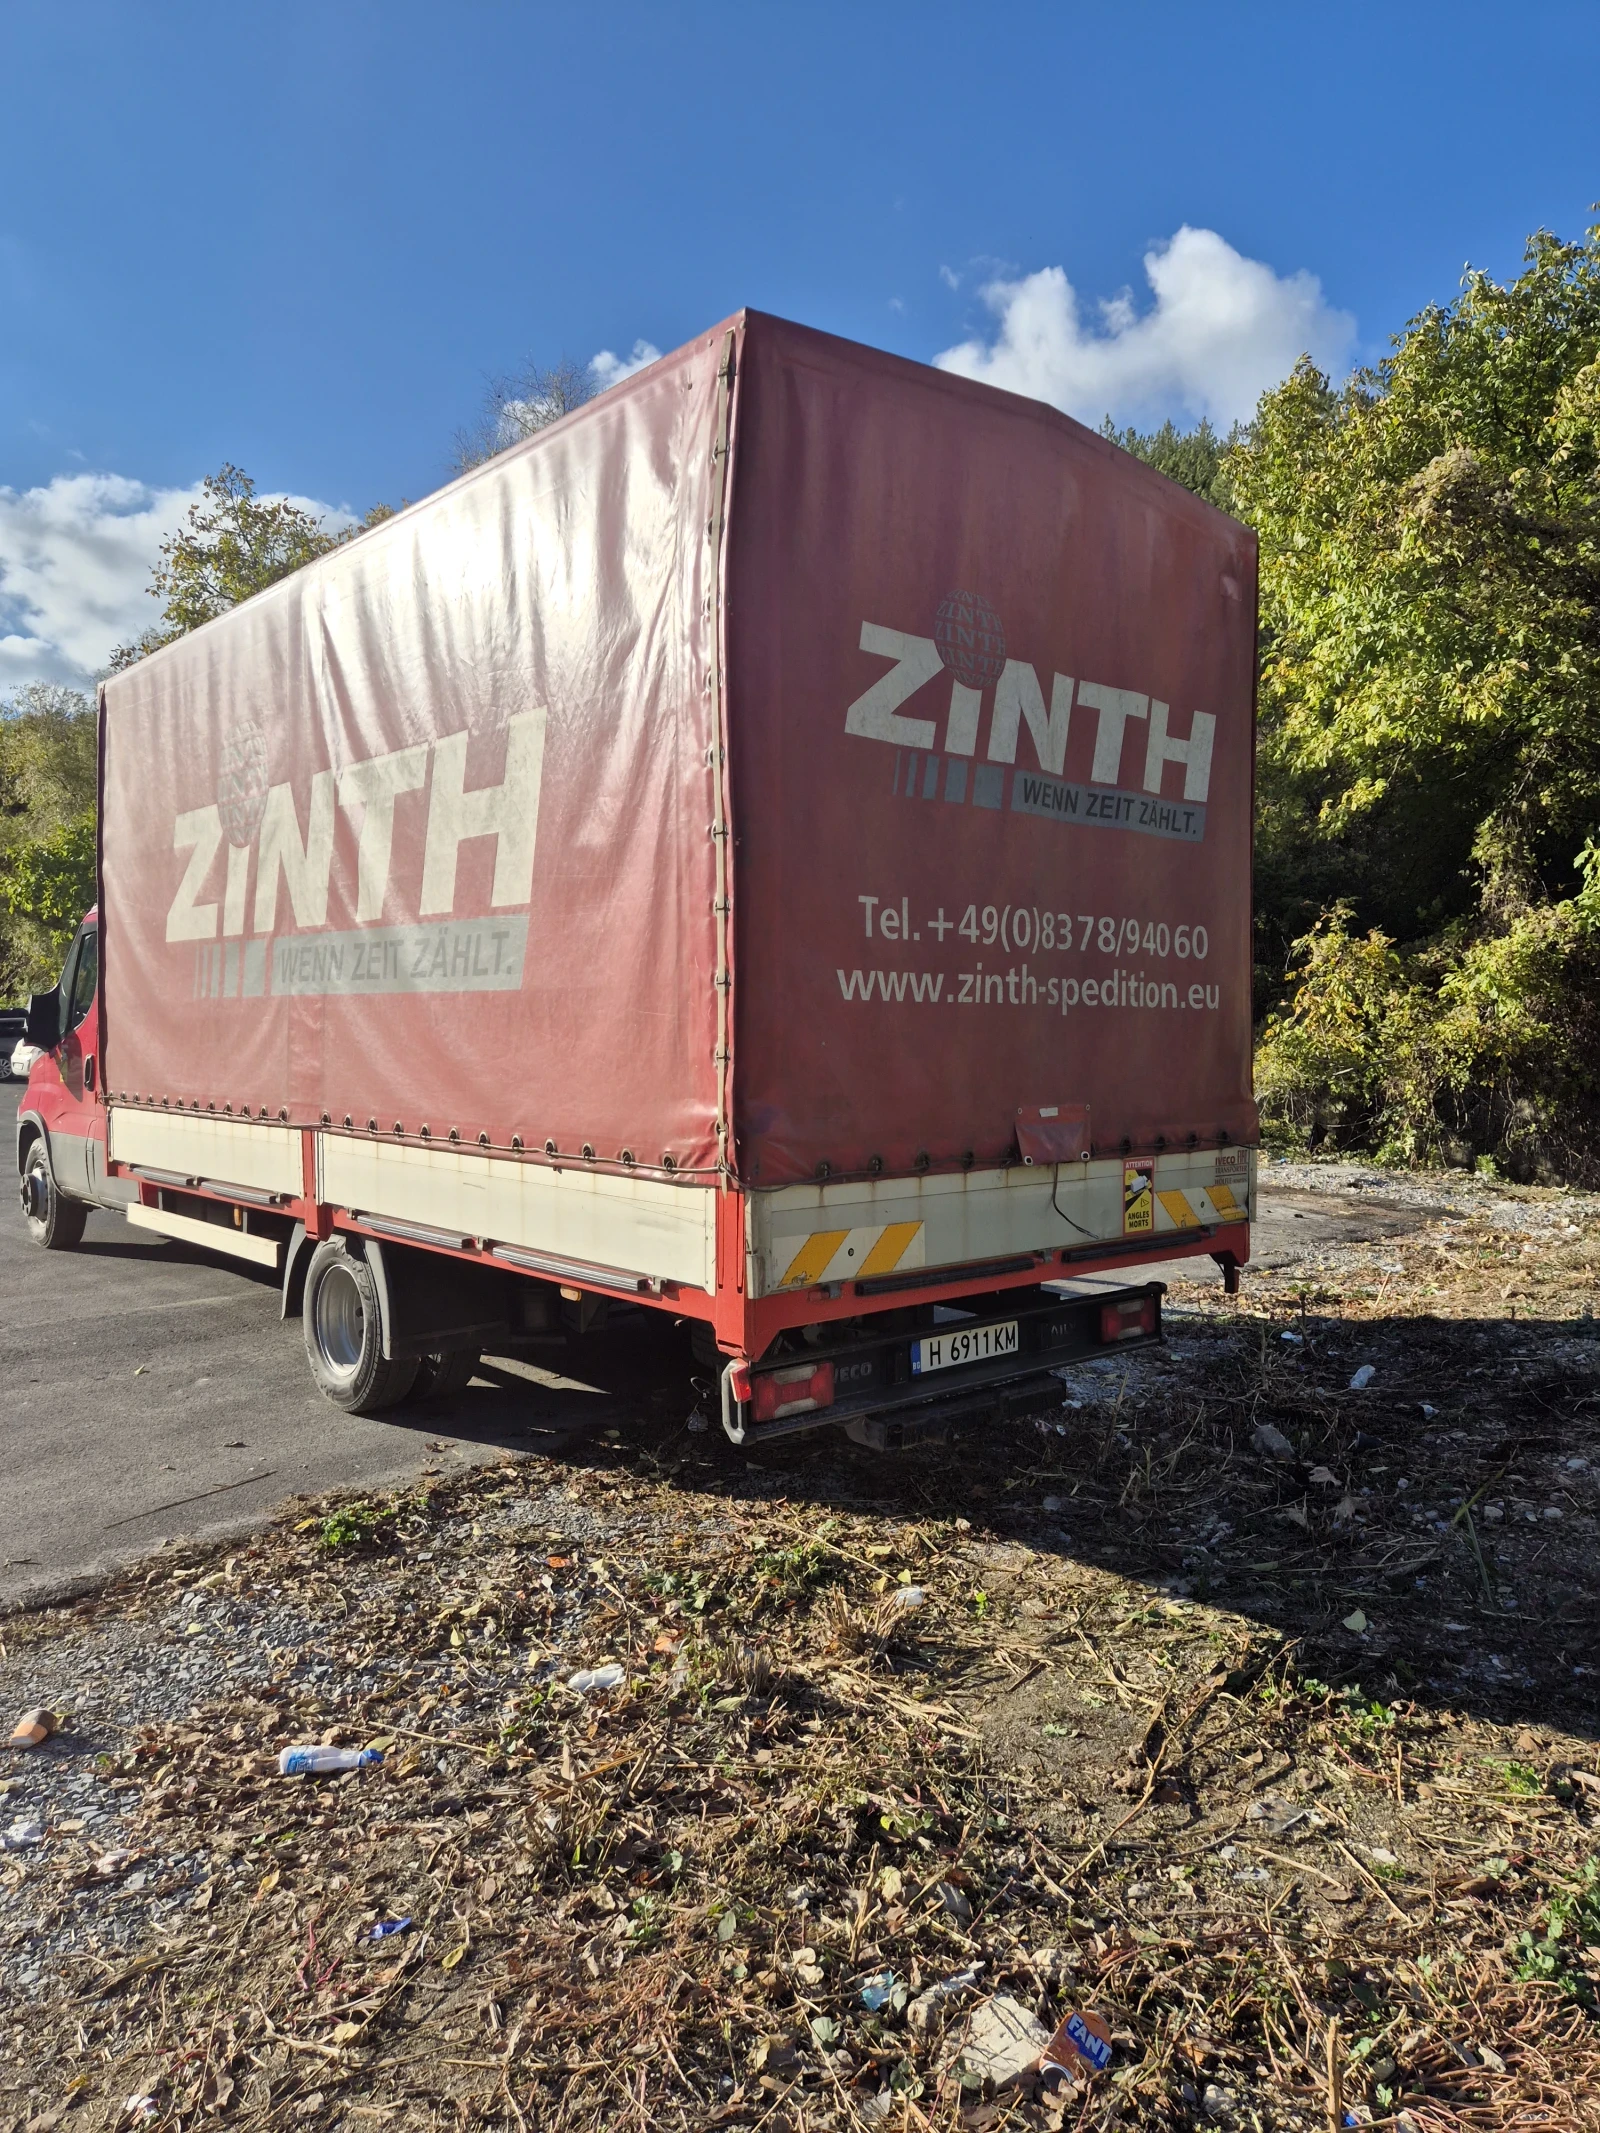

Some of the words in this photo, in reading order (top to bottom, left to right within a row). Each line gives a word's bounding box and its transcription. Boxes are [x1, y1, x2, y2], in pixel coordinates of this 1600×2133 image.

[844, 620, 1217, 802] ZINTH
[1022, 777, 1079, 815] WENN
[1085, 792, 1136, 821] ZEIT
[1138, 798, 1197, 835] ZÄHLT.
[166, 704, 547, 943] ZINTH
[281, 940, 345, 984] WENN
[351, 938, 405, 981] ZEIT
[410, 927, 513, 979] ZÄHLT.
[836, 962, 1220, 1016] www.zinth-spedition.eu
[1125, 1160, 1153, 1169] ATTENTION
[1215, 1156, 1236, 1166] IVECO
[1128, 1211, 1150, 1220] ANGLES
[1128, 1219, 1149, 1229] MORTS
[912, 1362, 921, 1370] BG
[929, 1340, 941, 1367] H
